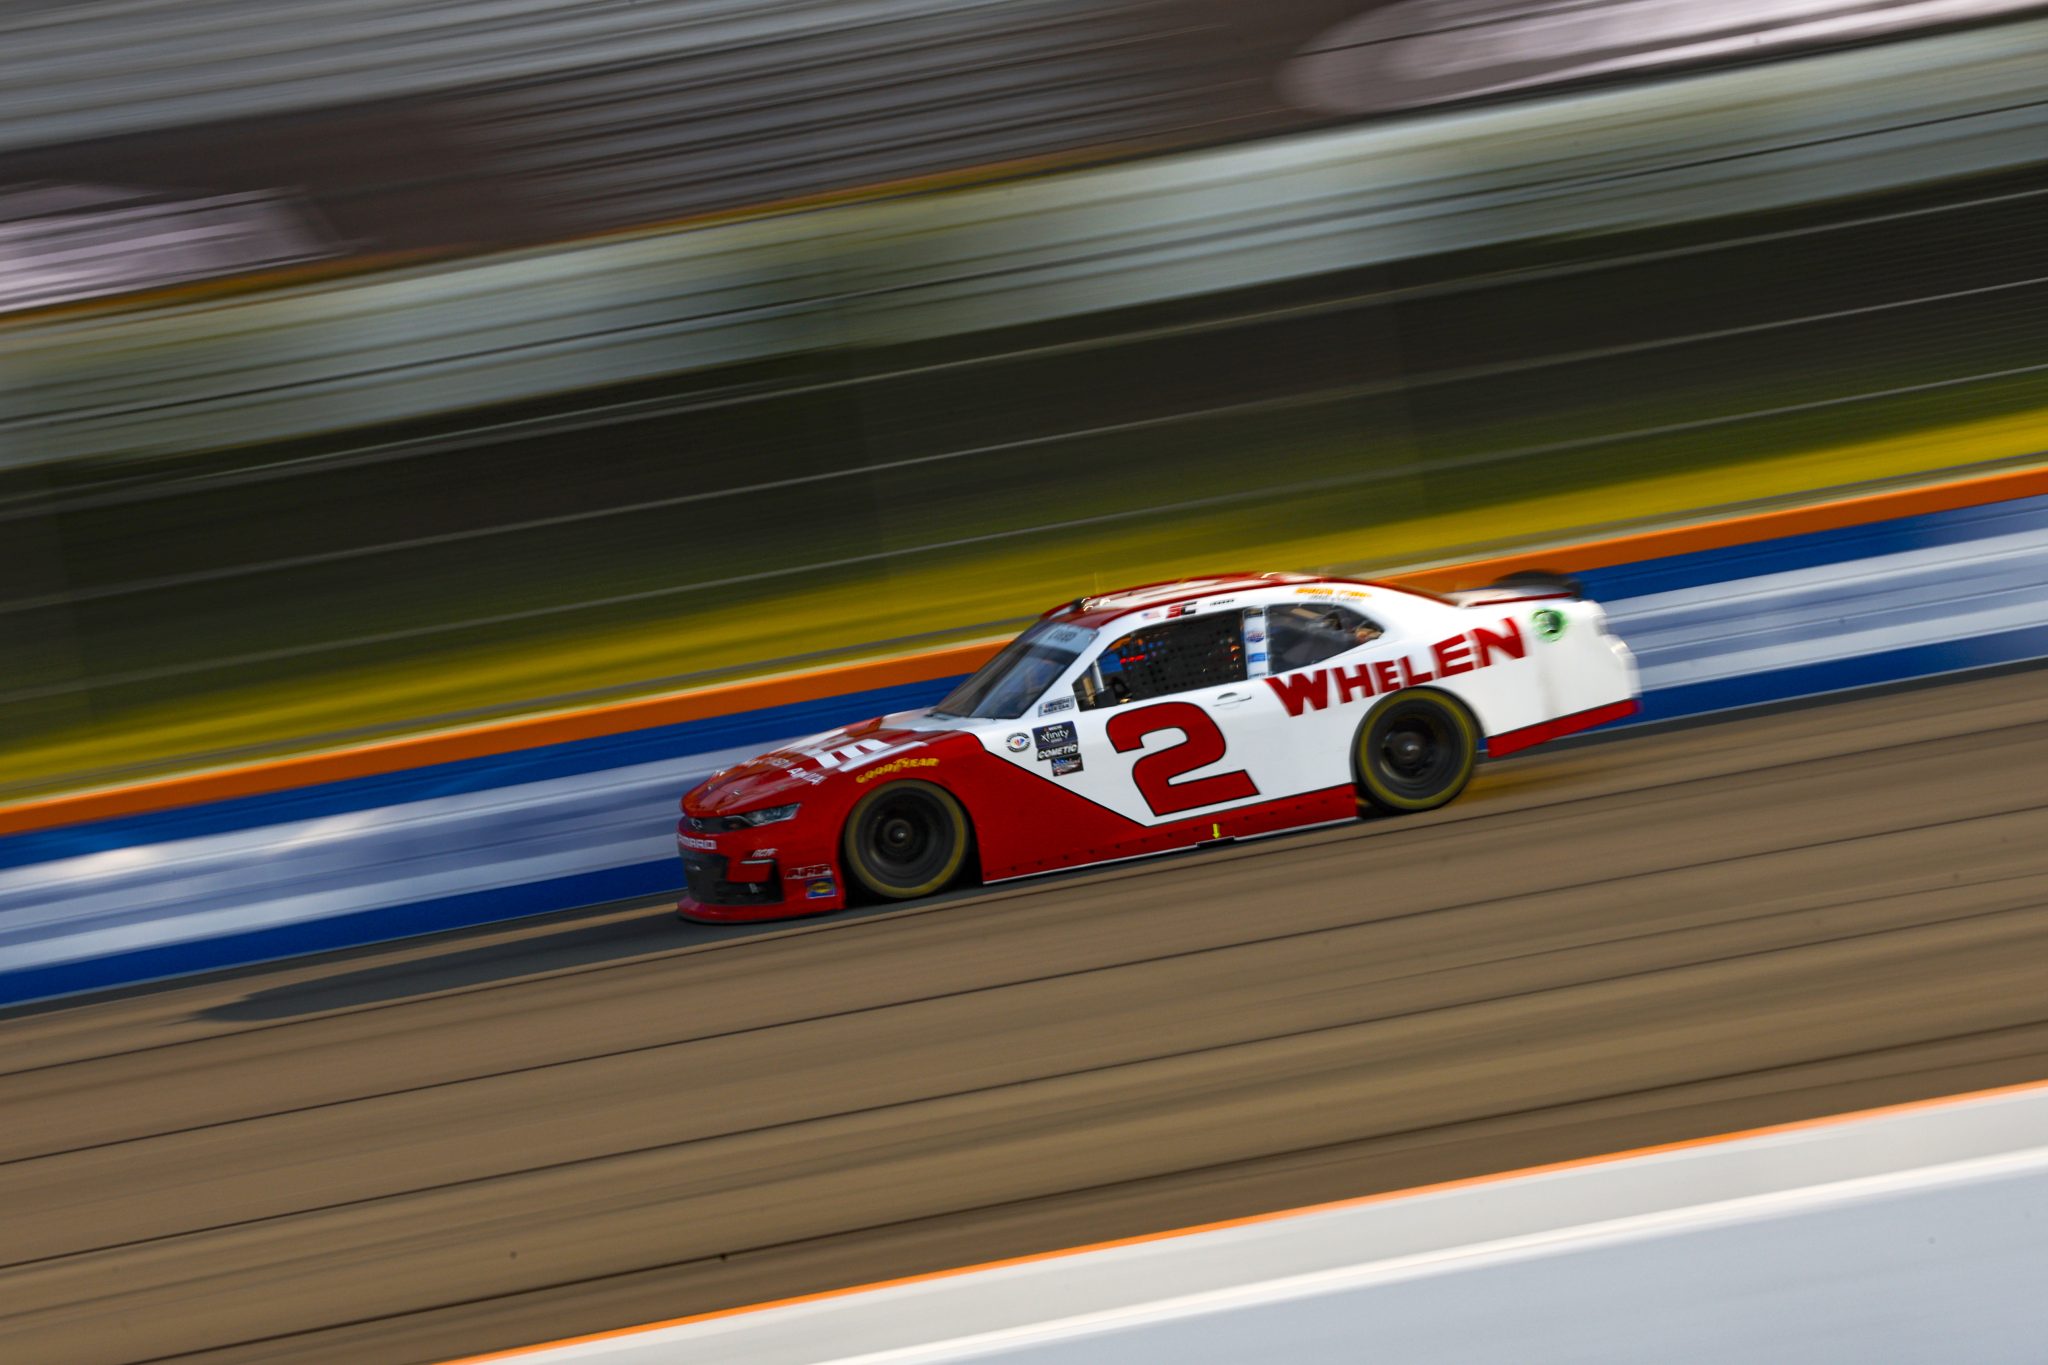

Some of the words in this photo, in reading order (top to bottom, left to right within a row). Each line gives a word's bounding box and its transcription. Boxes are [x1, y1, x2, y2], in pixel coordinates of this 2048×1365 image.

[1264, 617, 1527, 717] WHELEN
[1040, 729, 1070, 743] xfinity
[1038, 744, 1077, 760] COMETIC
[1106, 702, 1261, 817] 2
[855, 758, 940, 784] GOODYEAR
